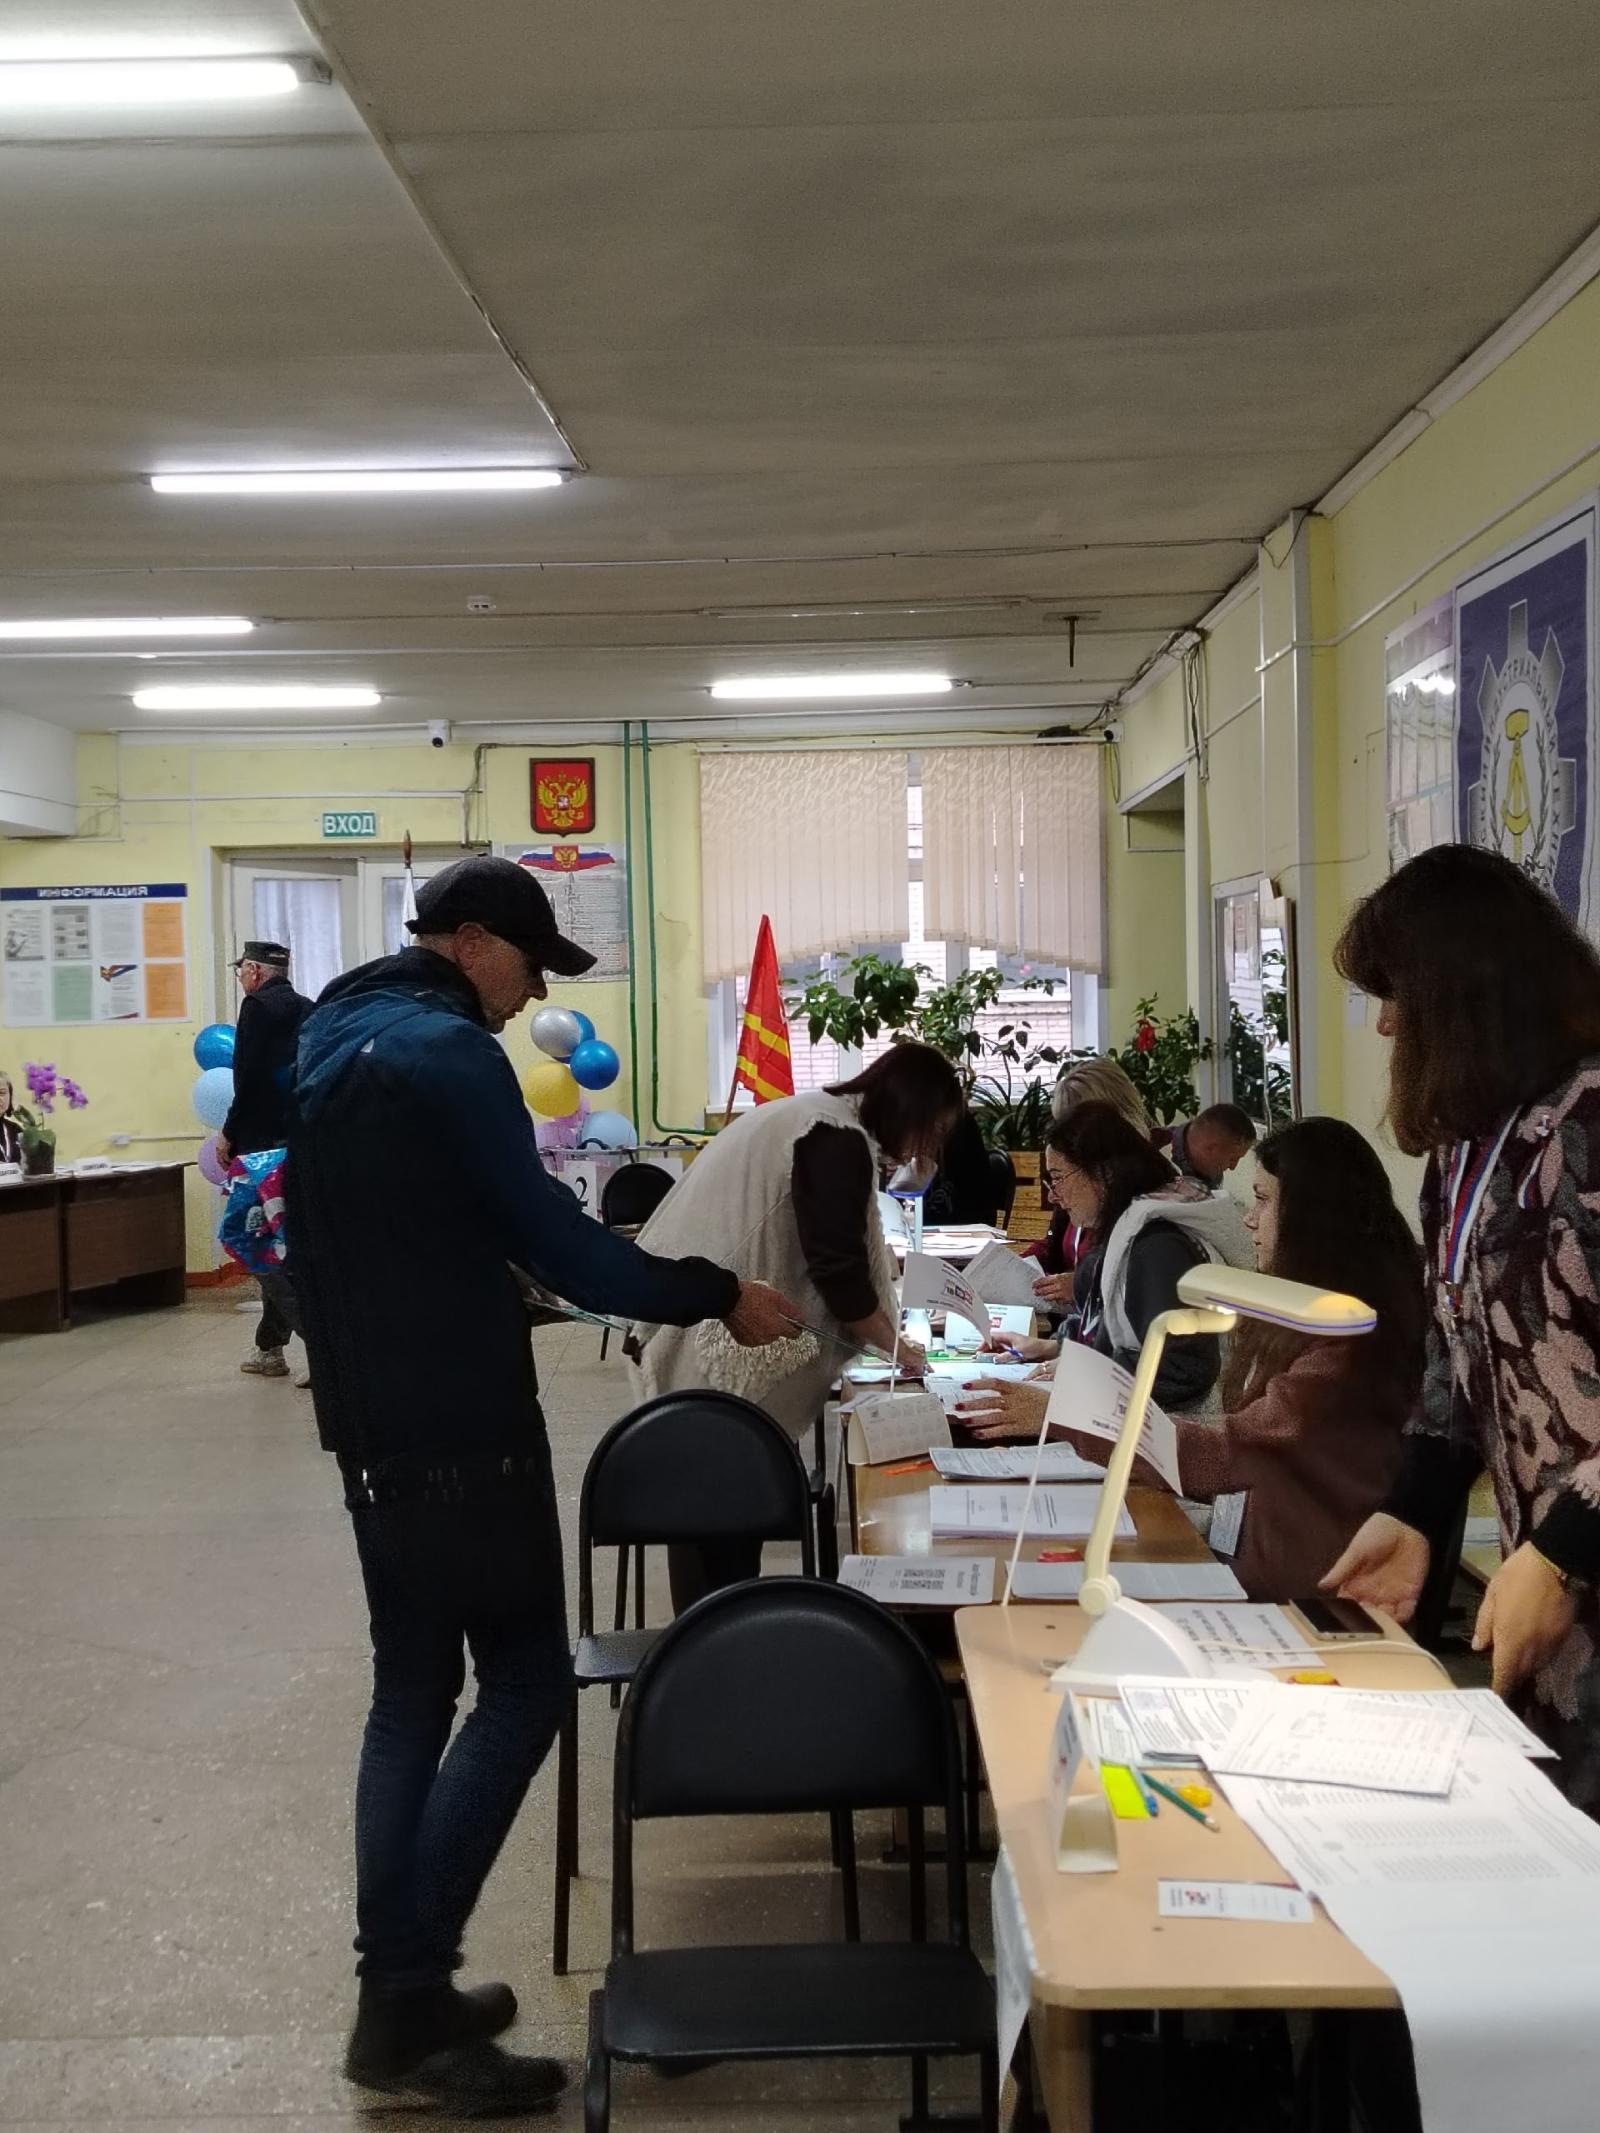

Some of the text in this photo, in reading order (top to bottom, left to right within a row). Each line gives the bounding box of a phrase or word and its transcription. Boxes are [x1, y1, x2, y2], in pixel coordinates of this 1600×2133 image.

[324, 815, 375, 833] ВХОД
[37, 886, 148, 898] ИНФОРМАЦИЯ
[575, 1176, 589, 1207] 2
